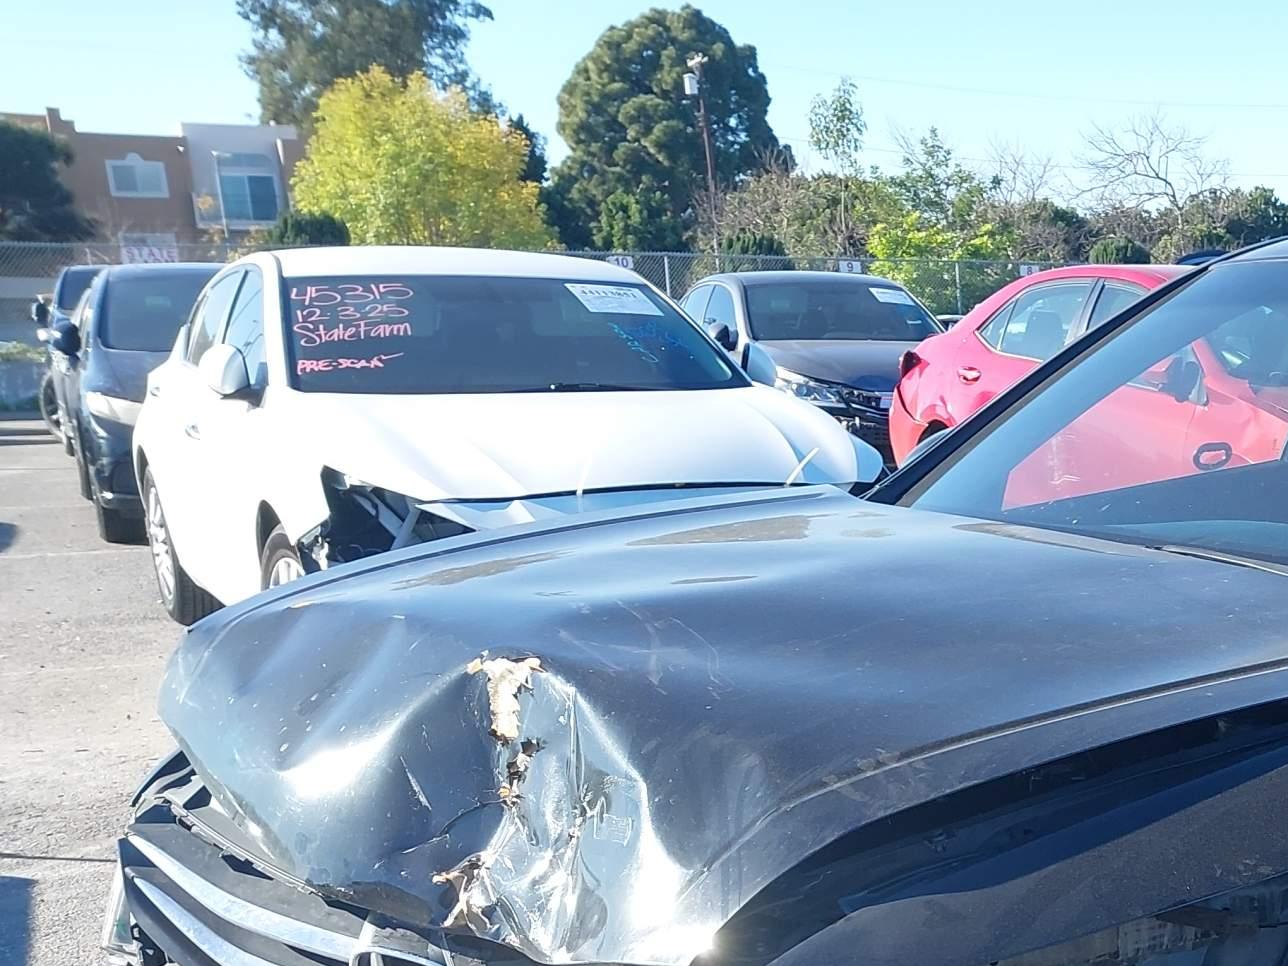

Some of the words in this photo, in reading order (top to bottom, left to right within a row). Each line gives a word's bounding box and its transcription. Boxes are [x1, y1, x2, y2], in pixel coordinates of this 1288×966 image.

[615, 257, 629, 268] 10
[847, 262, 854, 272] 9
[290, 283, 414, 306] 45315
